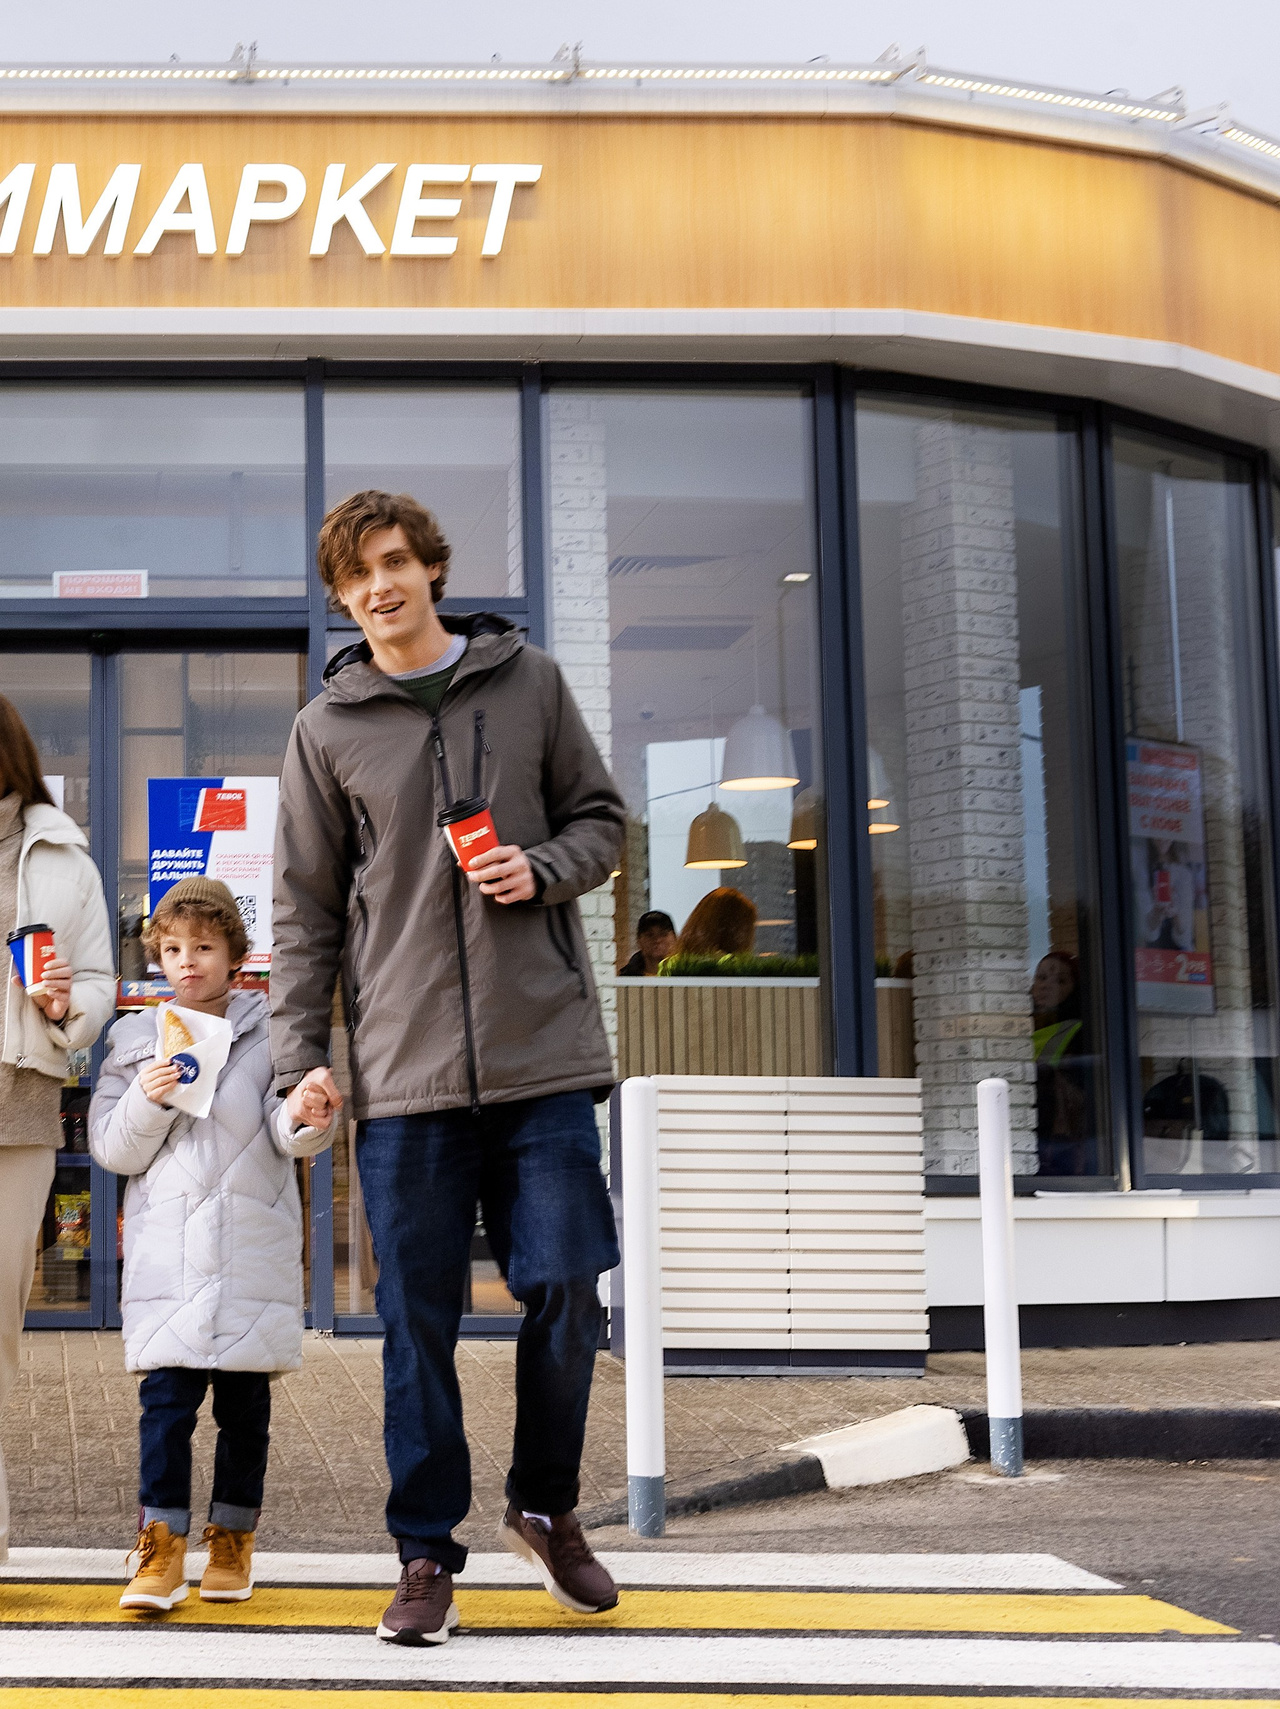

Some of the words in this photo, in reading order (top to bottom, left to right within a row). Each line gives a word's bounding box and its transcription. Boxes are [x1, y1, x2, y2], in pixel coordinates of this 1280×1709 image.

[216, 792, 243, 800] TEBOIL
[151, 847, 203, 860] ДАВАЙТЕ
[151, 860, 205, 871] ДРУЖИТЬ
